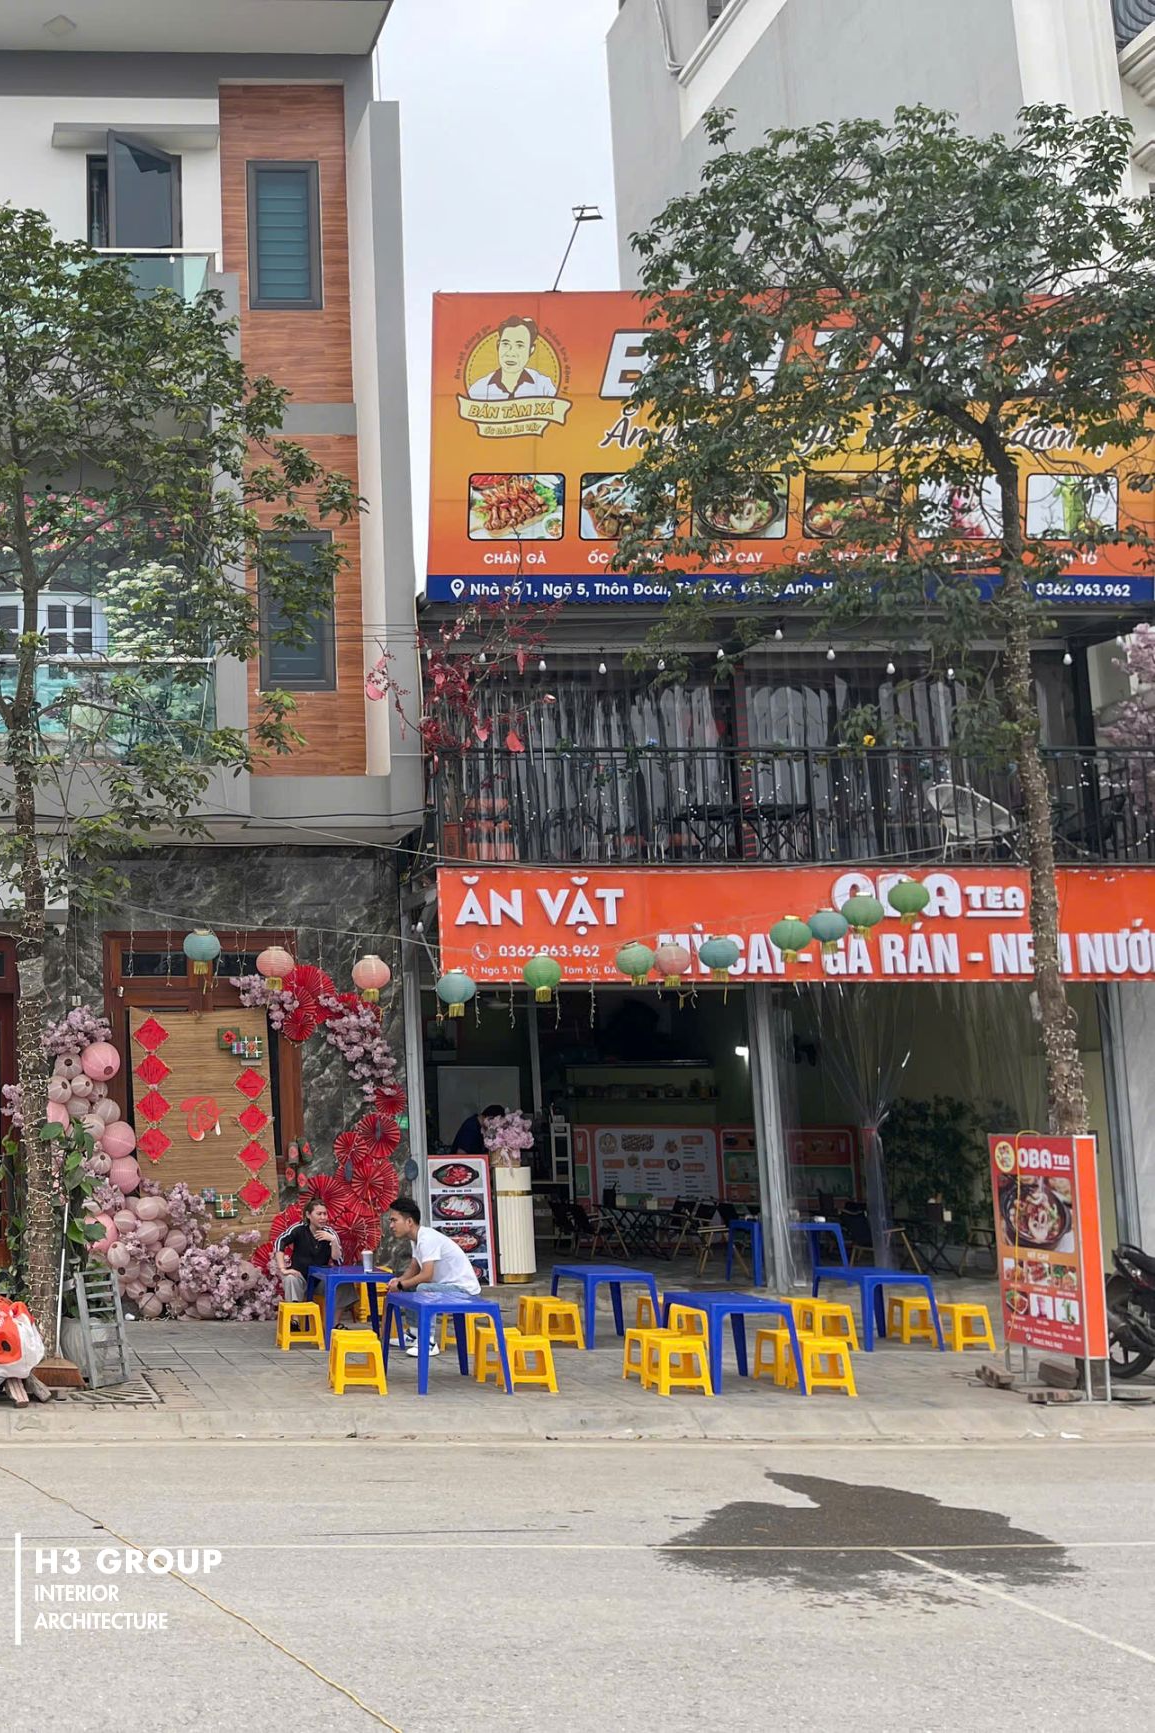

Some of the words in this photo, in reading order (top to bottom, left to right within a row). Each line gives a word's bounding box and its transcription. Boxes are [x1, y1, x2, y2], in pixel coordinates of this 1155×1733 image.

[599, 404, 647, 448] Ăn
[484, 551, 521, 564] CHÂN
[526, 551, 547, 564] GÀ
[588, 549, 608, 564] ỐC
[736, 552, 762, 563] CAY
[471, 582, 500, 596] Nhà
[505, 580, 521, 596] số
[527, 583, 538, 598] 1,
[543, 582, 573, 599] Ngõ
[577, 583, 590, 598] 5,
[594, 582, 629, 596] Thôn
[1036, 583, 1131, 597] 0362.963.962
[454, 875, 524, 927] ĂN
[536, 875, 625, 936] VẶT
[965, 886, 1025, 910] TEA
[499, 944, 600, 958] 0362963.962
[880, 921, 961, 975] RÁN
[989, 932, 1073, 975] NE
[1078, 917, 1155, 975] NƯỚ
[1018, 1148, 1053, 1169] OBA
[1053, 1154, 1070, 1166] TEA
